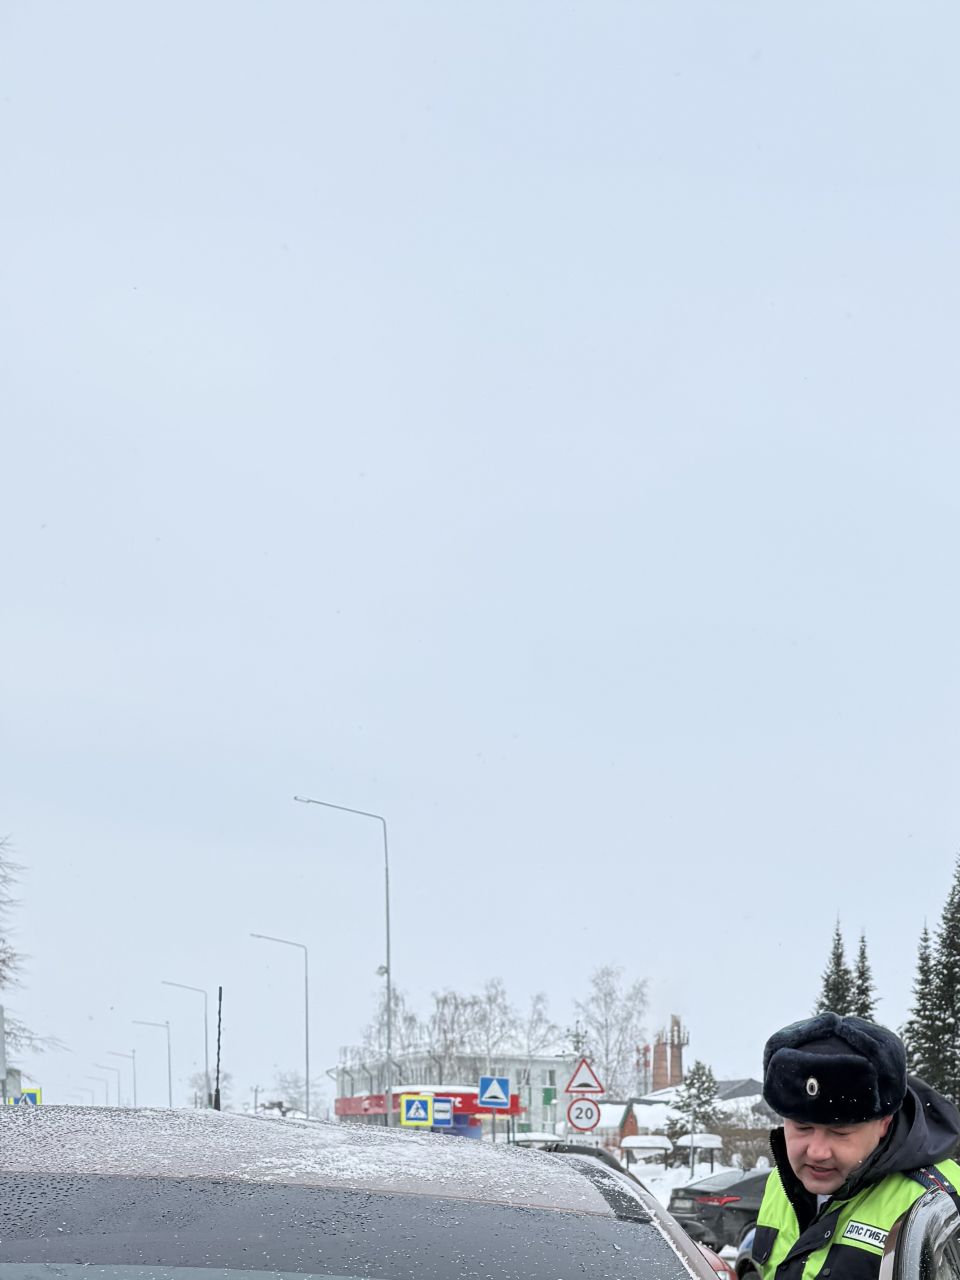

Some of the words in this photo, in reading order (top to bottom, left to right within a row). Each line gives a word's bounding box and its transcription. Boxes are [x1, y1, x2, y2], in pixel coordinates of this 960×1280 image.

[574, 1108, 593, 1119] 20
[846, 1225, 863, 1235] ДПС
[864, 1229, 887, 1244] ГИБД
